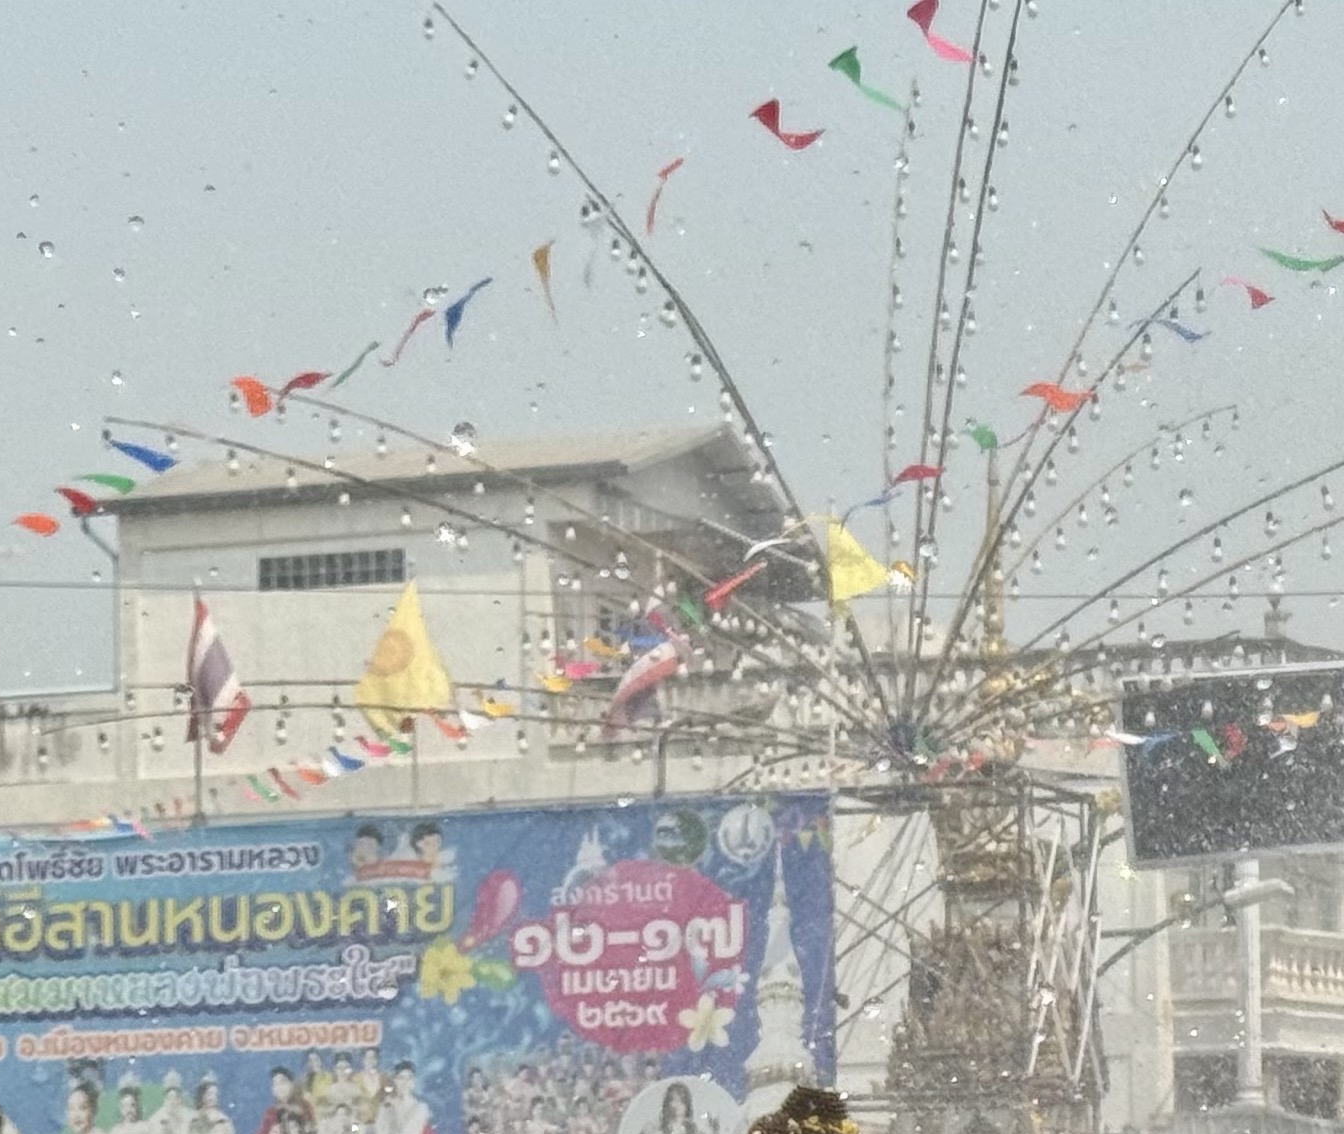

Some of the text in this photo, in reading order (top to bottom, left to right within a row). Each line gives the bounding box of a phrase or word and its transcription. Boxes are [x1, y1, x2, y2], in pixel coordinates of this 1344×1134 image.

[116, 844, 320, 876] พระอารามหลวง
[513, 903, 746, 968] ๑๒-๑๗
